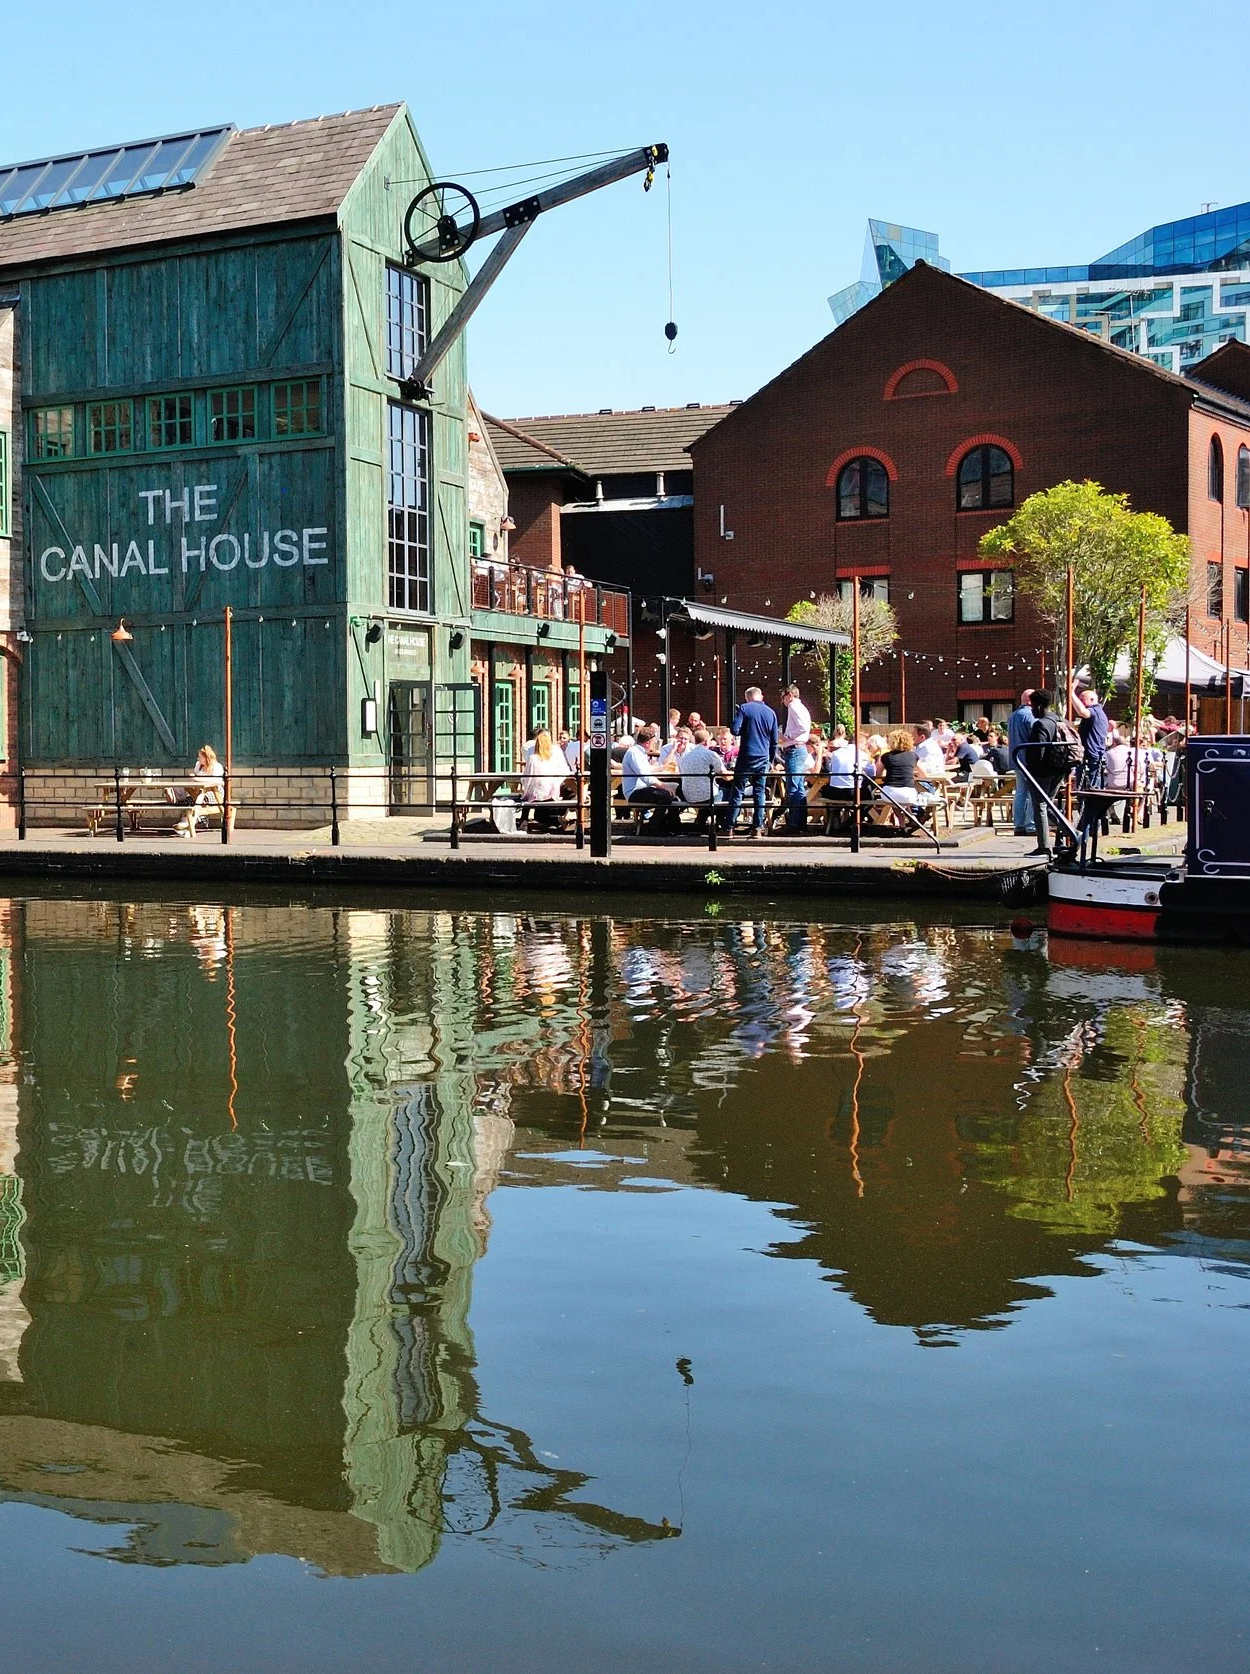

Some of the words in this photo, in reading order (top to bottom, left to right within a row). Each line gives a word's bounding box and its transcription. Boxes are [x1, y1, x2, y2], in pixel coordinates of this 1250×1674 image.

[139, 484, 218, 525] THE
[40, 540, 169, 582] CANAL
[181, 527, 329, 573] HOUSE
